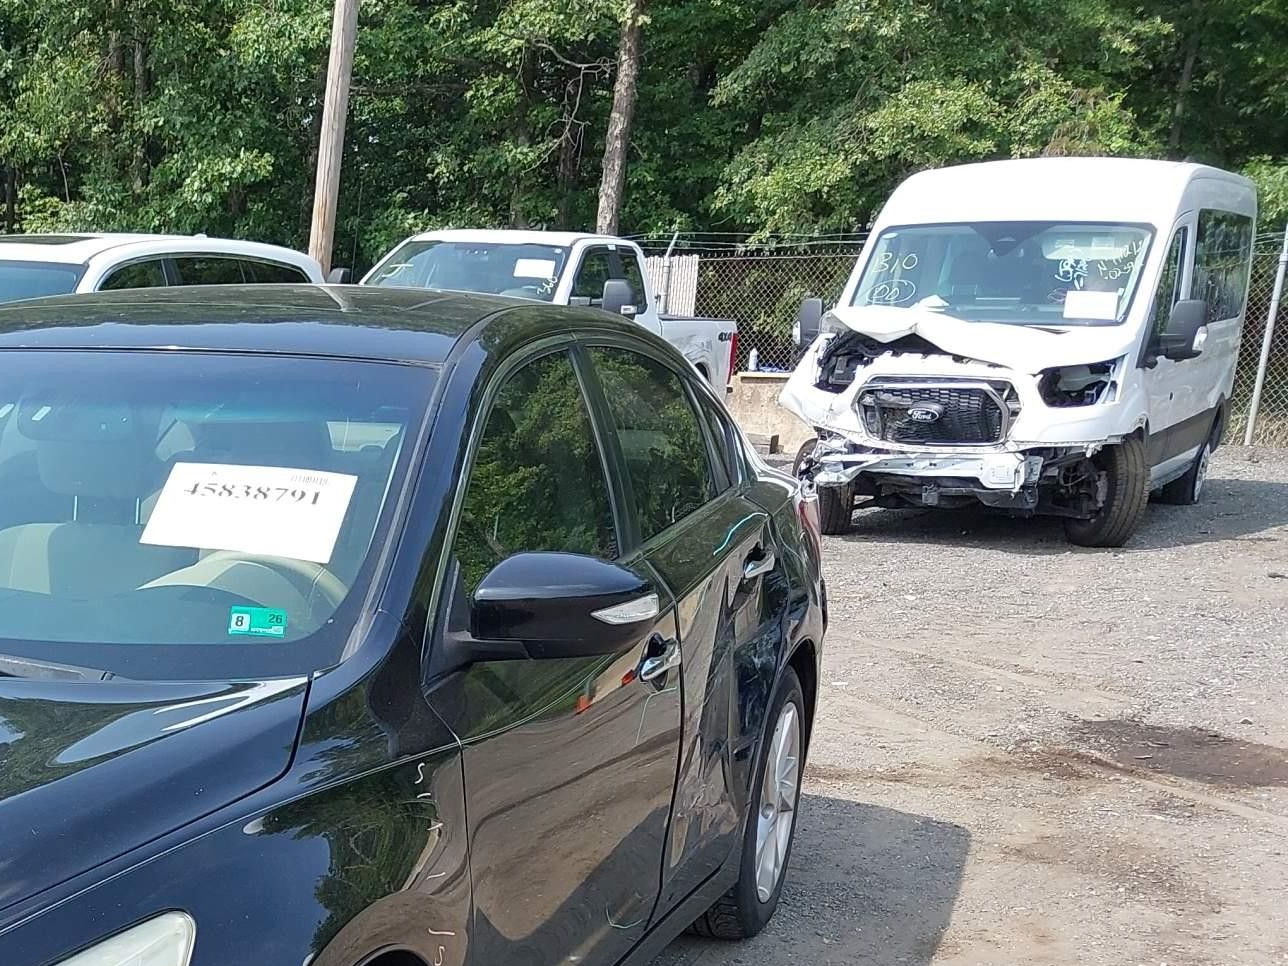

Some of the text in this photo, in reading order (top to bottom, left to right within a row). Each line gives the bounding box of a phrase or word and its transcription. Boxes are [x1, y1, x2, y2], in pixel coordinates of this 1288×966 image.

[184, 481, 321, 505] 45838791
[235, 613, 283, 627] 8 26
